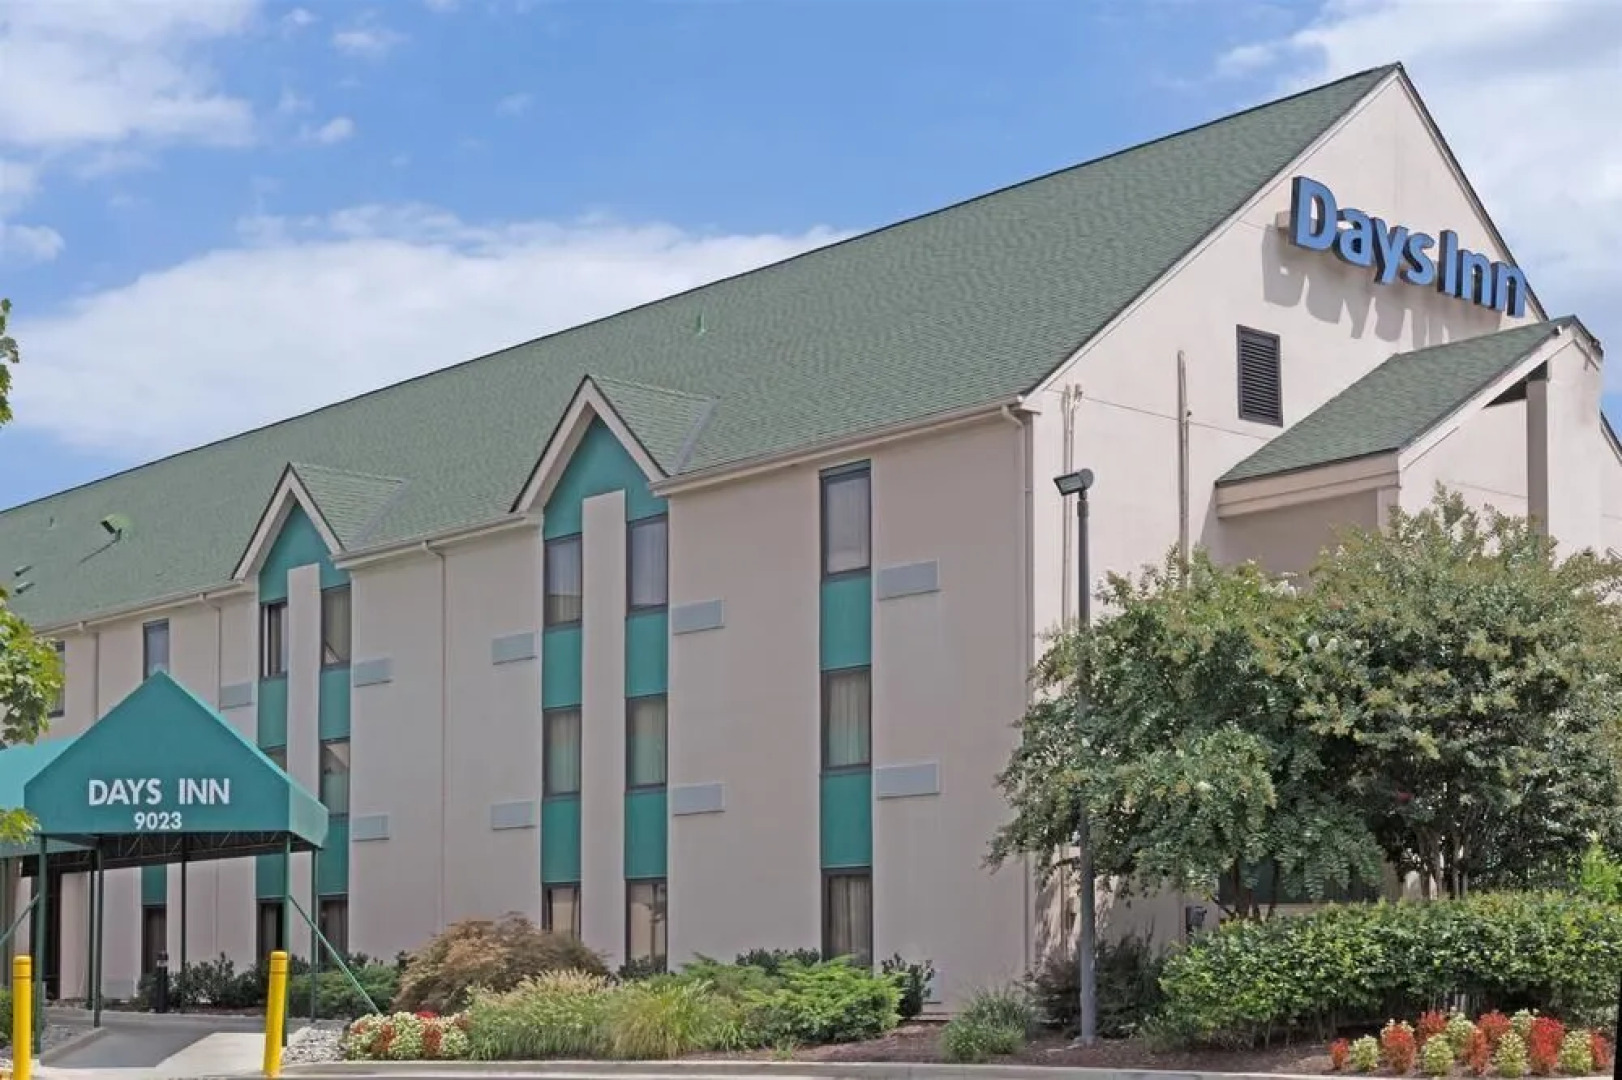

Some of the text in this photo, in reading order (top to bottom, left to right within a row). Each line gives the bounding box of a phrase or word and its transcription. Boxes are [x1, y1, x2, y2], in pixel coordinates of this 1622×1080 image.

[88, 777, 231, 806] DAYS INN
[134, 811, 183, 831] 9023
